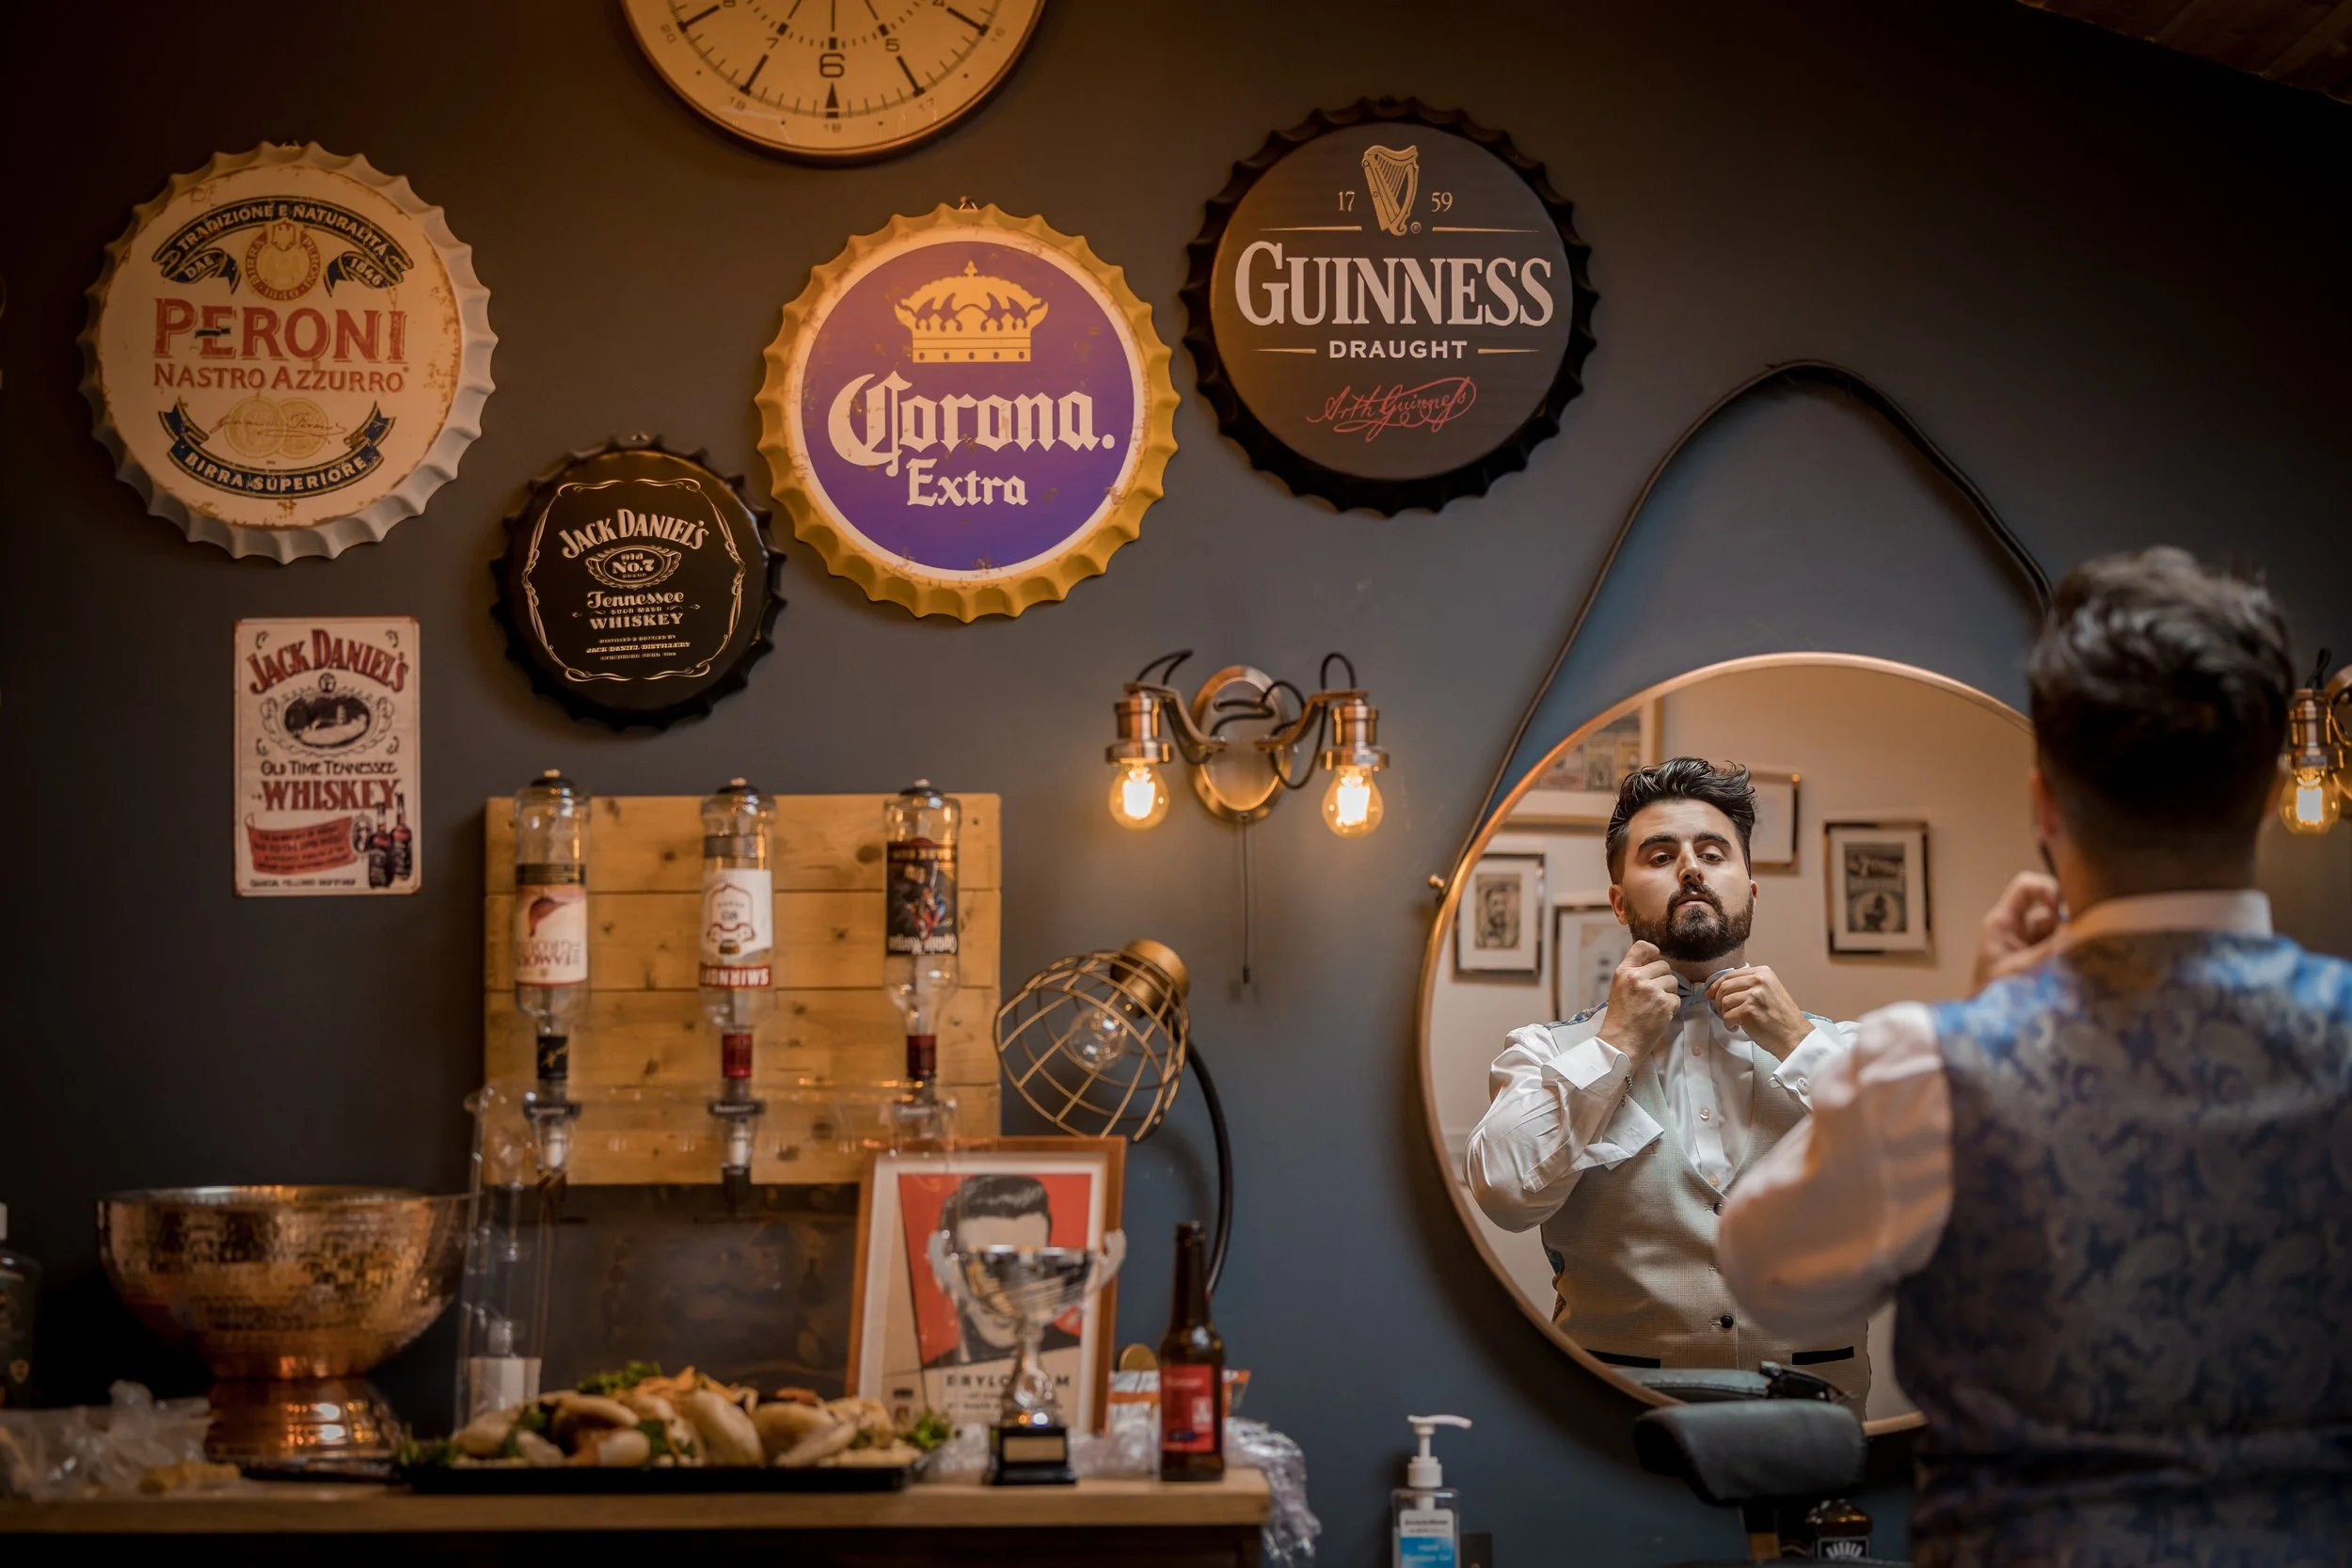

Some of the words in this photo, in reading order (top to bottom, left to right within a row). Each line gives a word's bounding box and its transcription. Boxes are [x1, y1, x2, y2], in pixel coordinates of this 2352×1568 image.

[766, 38, 779, 49] 7
[885, 39, 900, 53] 5
[819, 54, 845, 78] 6
[1338, 191, 1355, 212] 17
[1431, 191, 1453, 213] 59
[177, 204, 274, 251] TRADIZIONE
[278, 204, 288, 217] E
[1234, 240, 1554, 327] GUINNESS
[152, 298, 408, 364] PERONI
[1328, 340, 1468, 359] DRAUGHT
[152, 362, 266, 389] NASTRO
[271, 365, 405, 393] AZZURRO
[184, 453, 244, 488] BIRRA
[252, 456, 368, 491] SUPERIORE
[906, 458, 1029, 507] Extra
[558, 516, 617, 559] JACK
[587, 591, 685, 609] Tennessee
[589, 612, 684, 629] WHISKEY
[246, 640, 311, 695] JACK
[261, 760, 287, 776] OLD
[289, 760, 322, 775] TIME
[324, 760, 398, 775] TENNESSEE
[261, 779, 402, 811] WHISKEY
